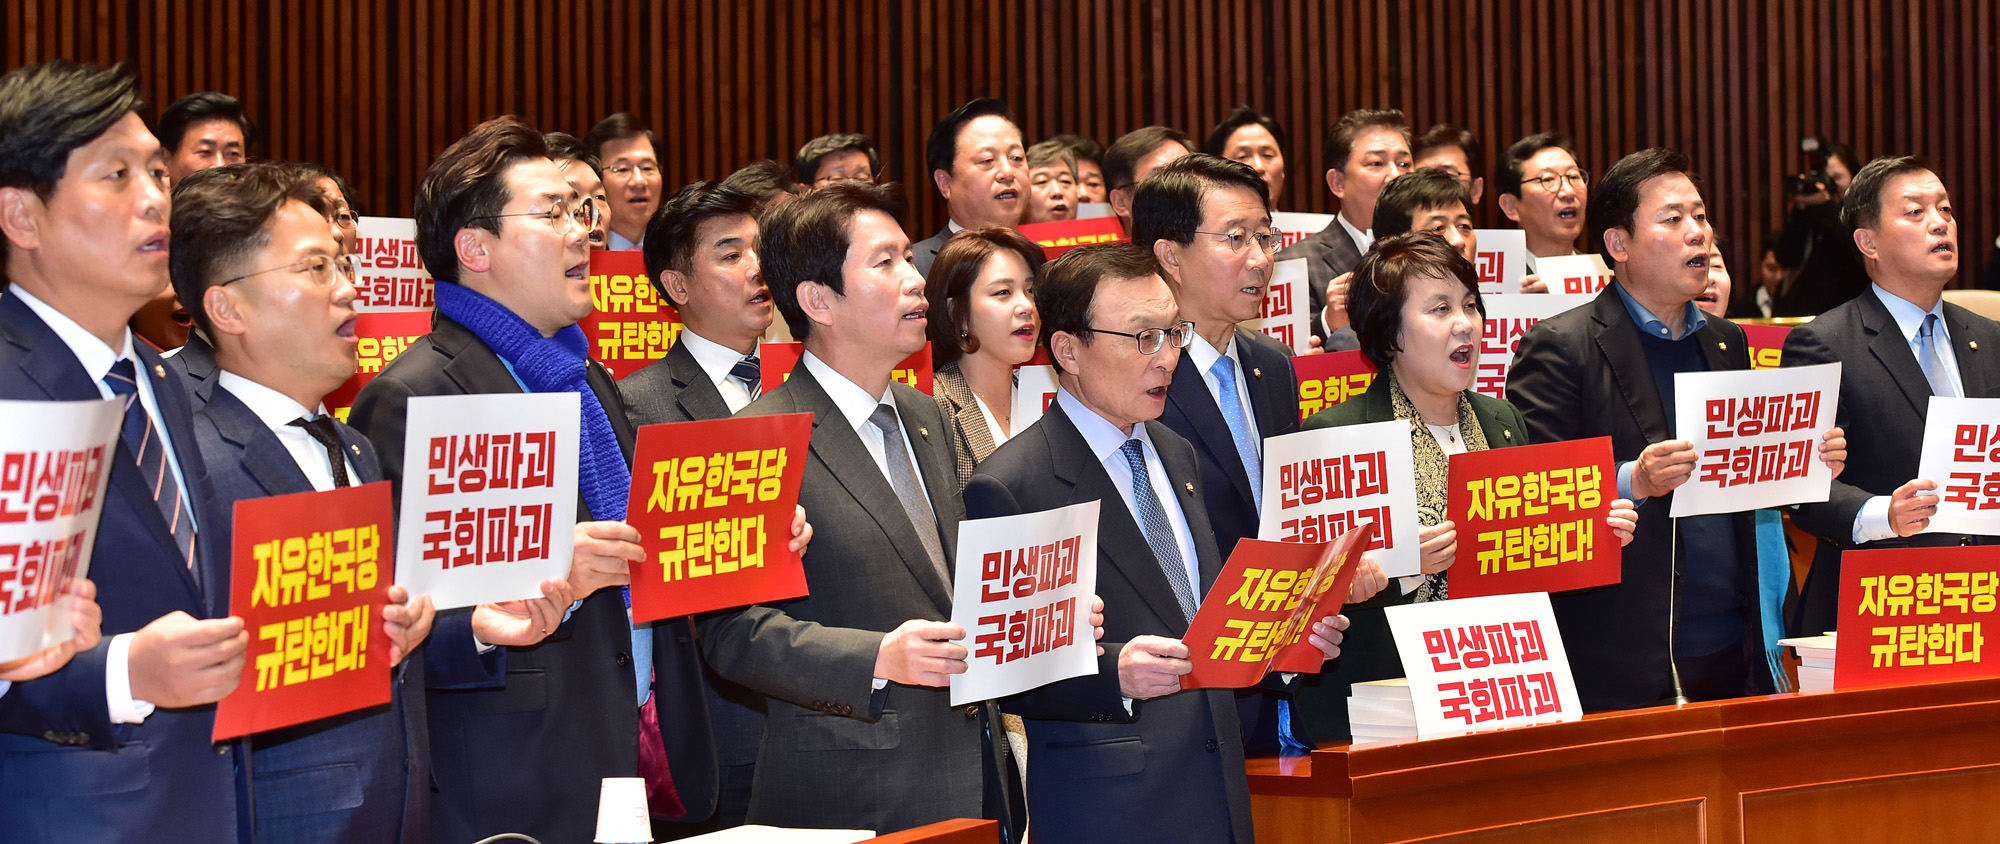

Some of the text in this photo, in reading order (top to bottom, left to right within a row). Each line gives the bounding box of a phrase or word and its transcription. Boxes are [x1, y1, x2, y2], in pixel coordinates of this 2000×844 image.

[1705, 391, 1821, 439] 민생파괴
[428, 431, 556, 495] 민생파괴
[647, 447, 788, 513] 자유한국당
[1280, 451, 1388, 509] 민생파괴
[1700, 440, 1813, 488] 국회파괴
[1466, 465, 1602, 521] 자유한국당
[423, 503, 552, 570] 국회파괴
[658, 514, 767, 583] 규탄한다
[1476, 519, 1593, 576] 규탄한다!
[251, 524, 380, 608] 자유한국당
[981, 535, 1081, 603] 민생파괴
[1858, 571, 2000, 616] 자유한국당
[255, 605, 369, 692] 규탄한다!
[974, 597, 1076, 665] 국회파괴
[1422, 620, 1548, 673] 민생파괴
[1870, 622, 1984, 668] 규탄한다
[1437, 671, 1562, 725] 국회파괴
